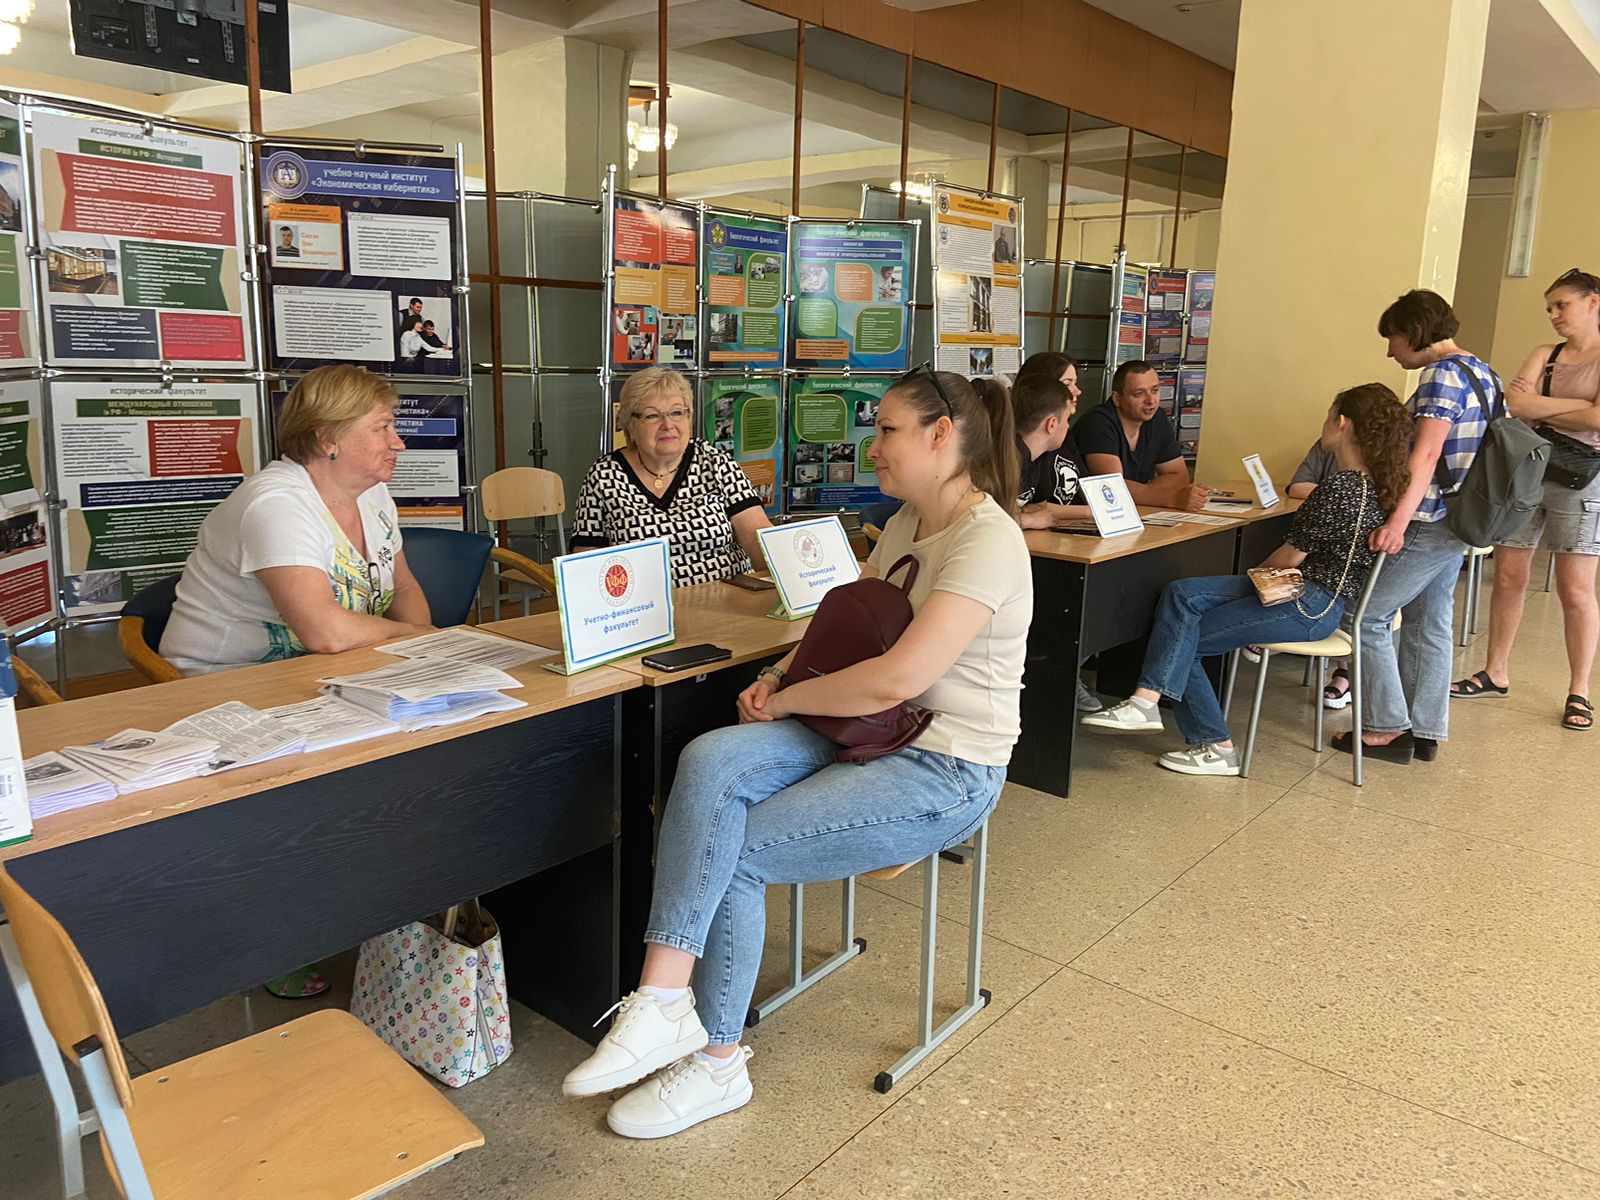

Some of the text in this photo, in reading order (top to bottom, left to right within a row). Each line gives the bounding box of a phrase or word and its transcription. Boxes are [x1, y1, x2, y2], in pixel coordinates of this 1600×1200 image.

[323, 168, 428, 184] учебно-научный институт
[311, 177, 441, 195] «Экономическая кибернетика»
[110, 388, 207, 396] исторический факультет
[583, 600, 655, 626] Учетно-финансовый
[603, 617, 639, 635] факультет
